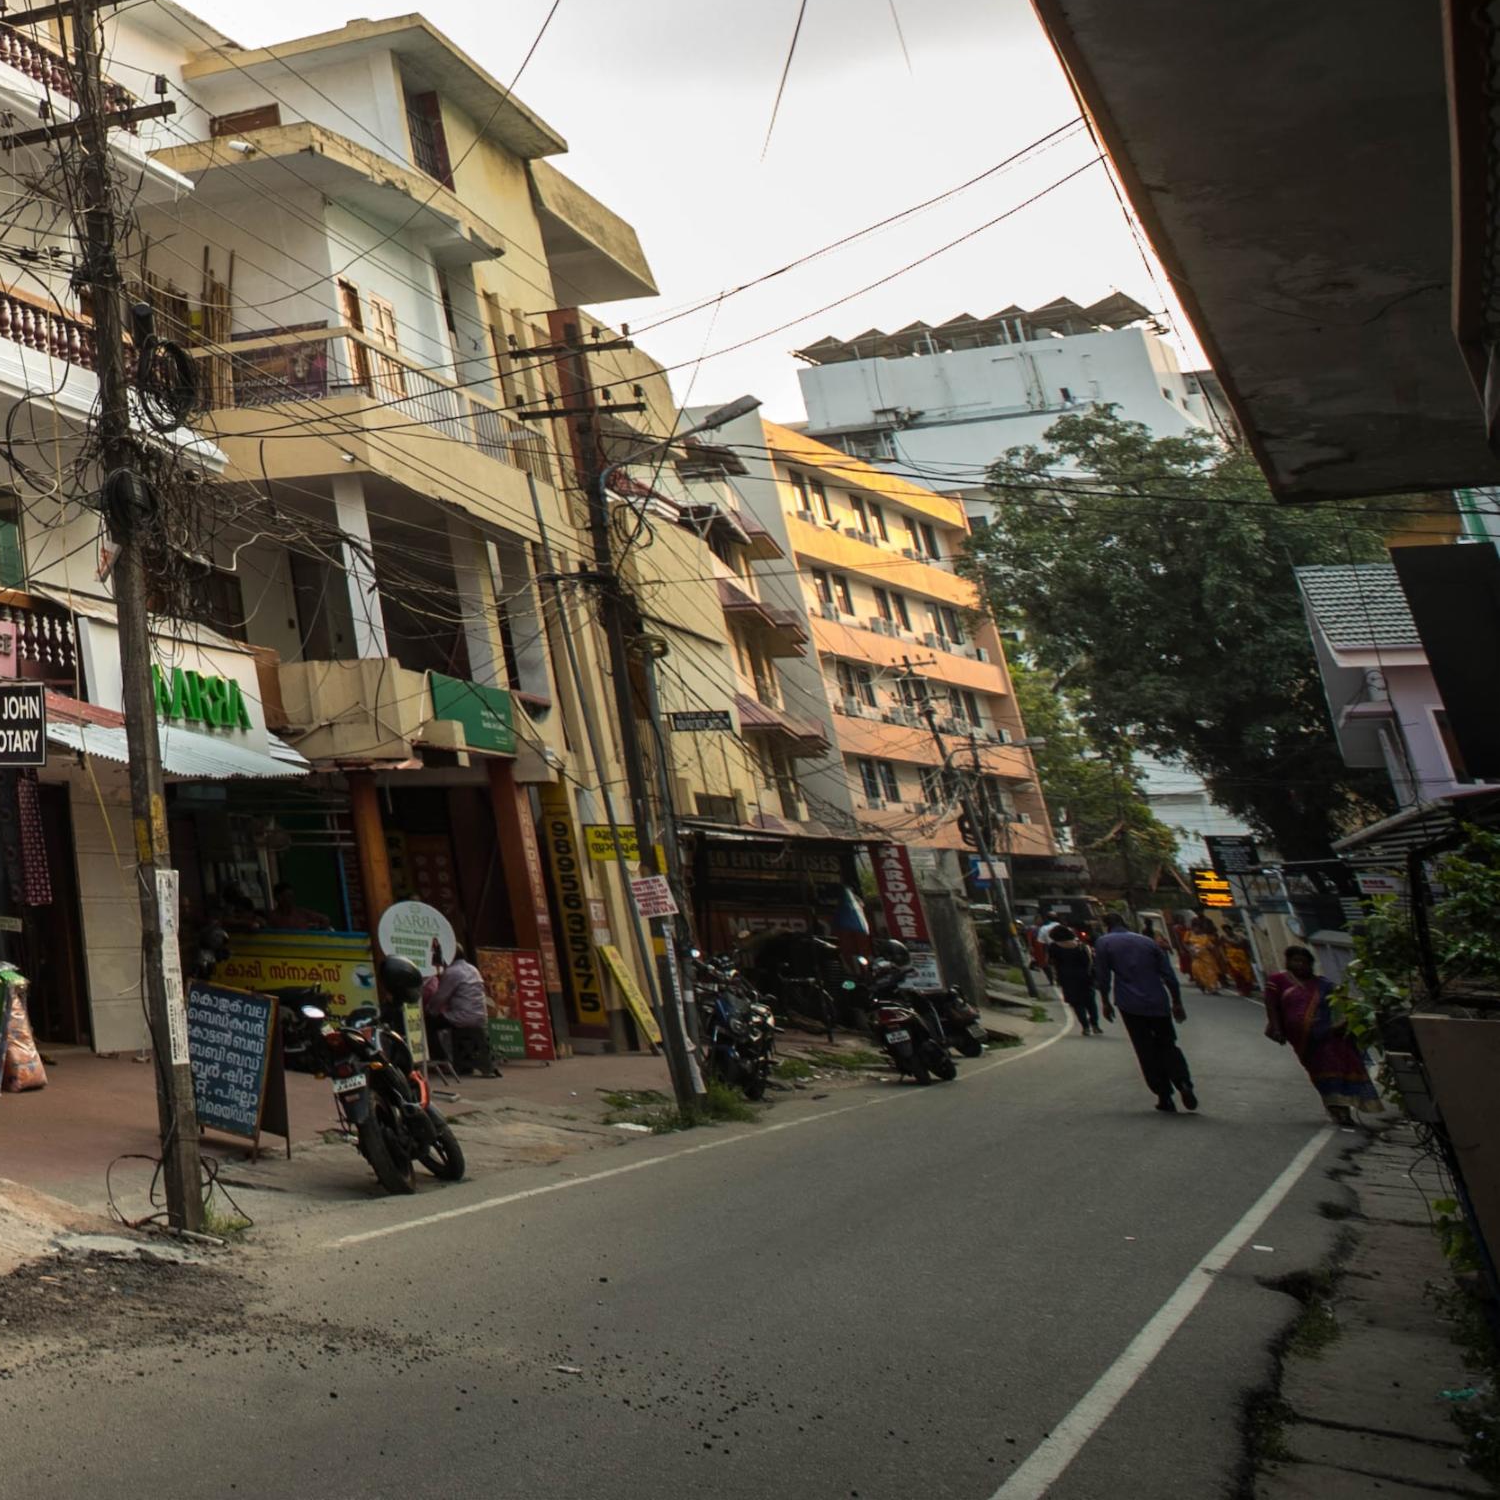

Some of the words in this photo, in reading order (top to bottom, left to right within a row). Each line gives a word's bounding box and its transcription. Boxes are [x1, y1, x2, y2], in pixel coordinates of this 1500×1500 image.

[2, 695, 41, 720] JOHN
[878, 847, 919, 938] HARDWARE
[517, 957, 550, 1052] PHOTOSTAT
